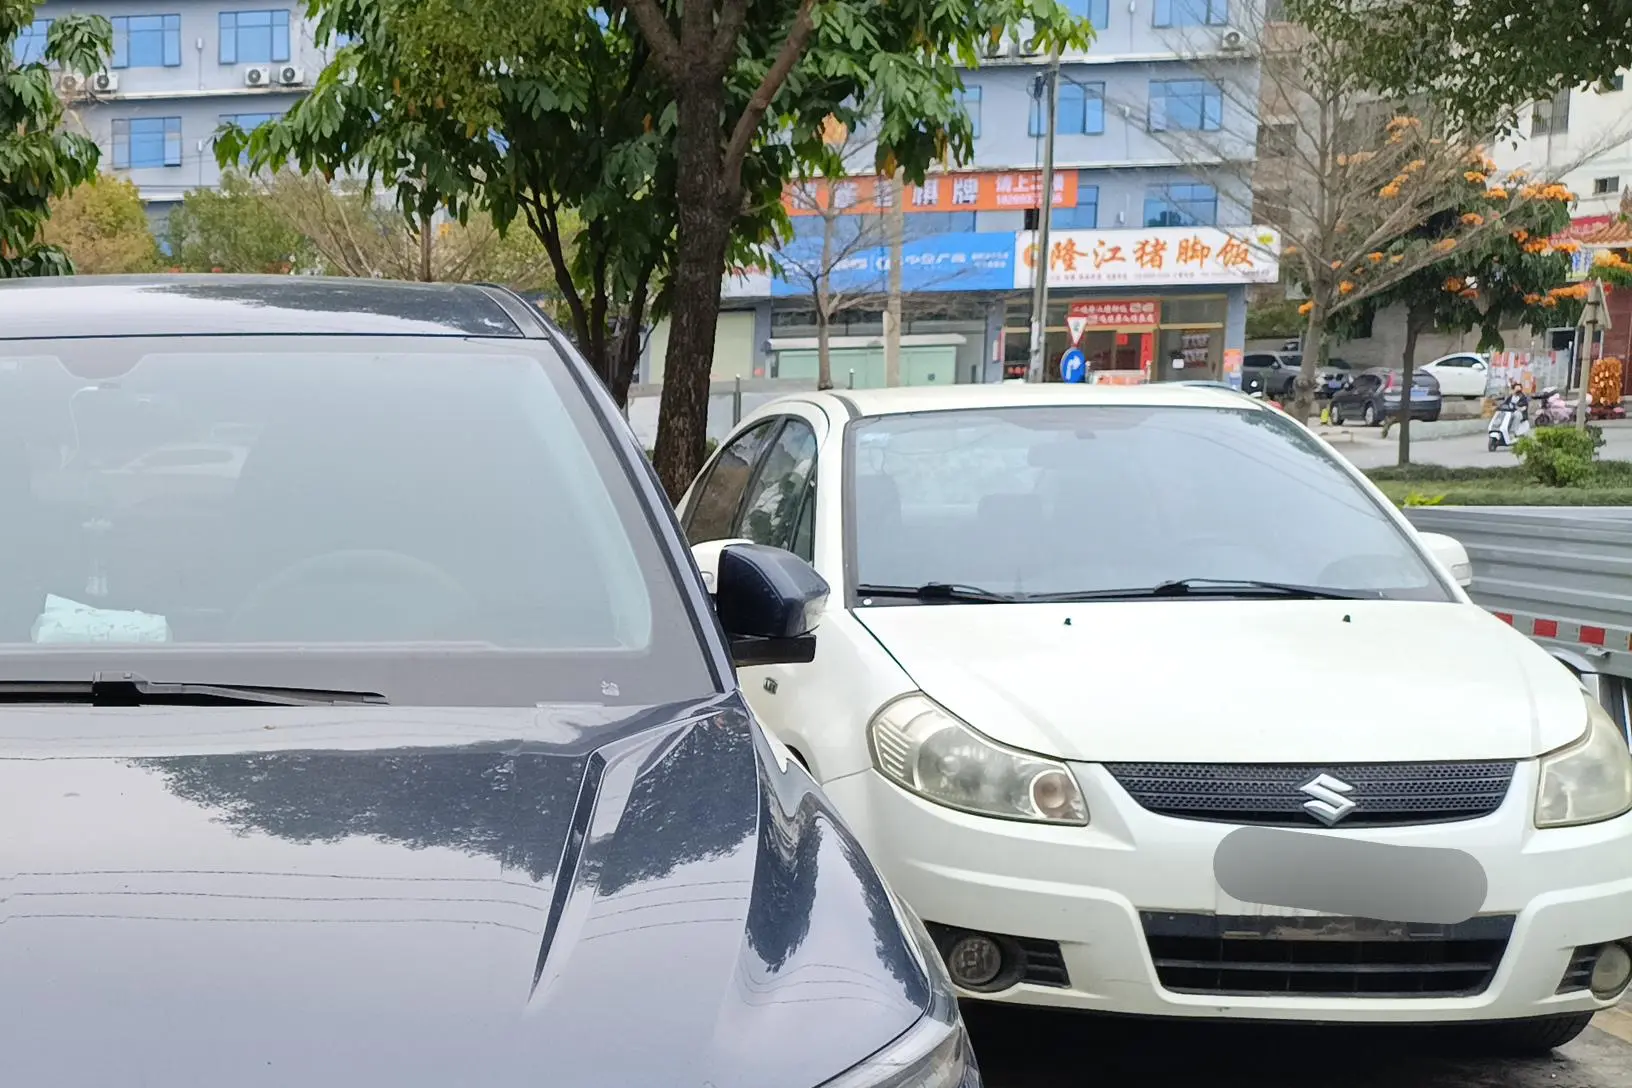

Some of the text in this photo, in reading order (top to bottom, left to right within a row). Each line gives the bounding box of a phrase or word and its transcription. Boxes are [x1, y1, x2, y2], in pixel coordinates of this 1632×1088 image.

[1051, 234, 1254, 270] 隆江猪脚饭
